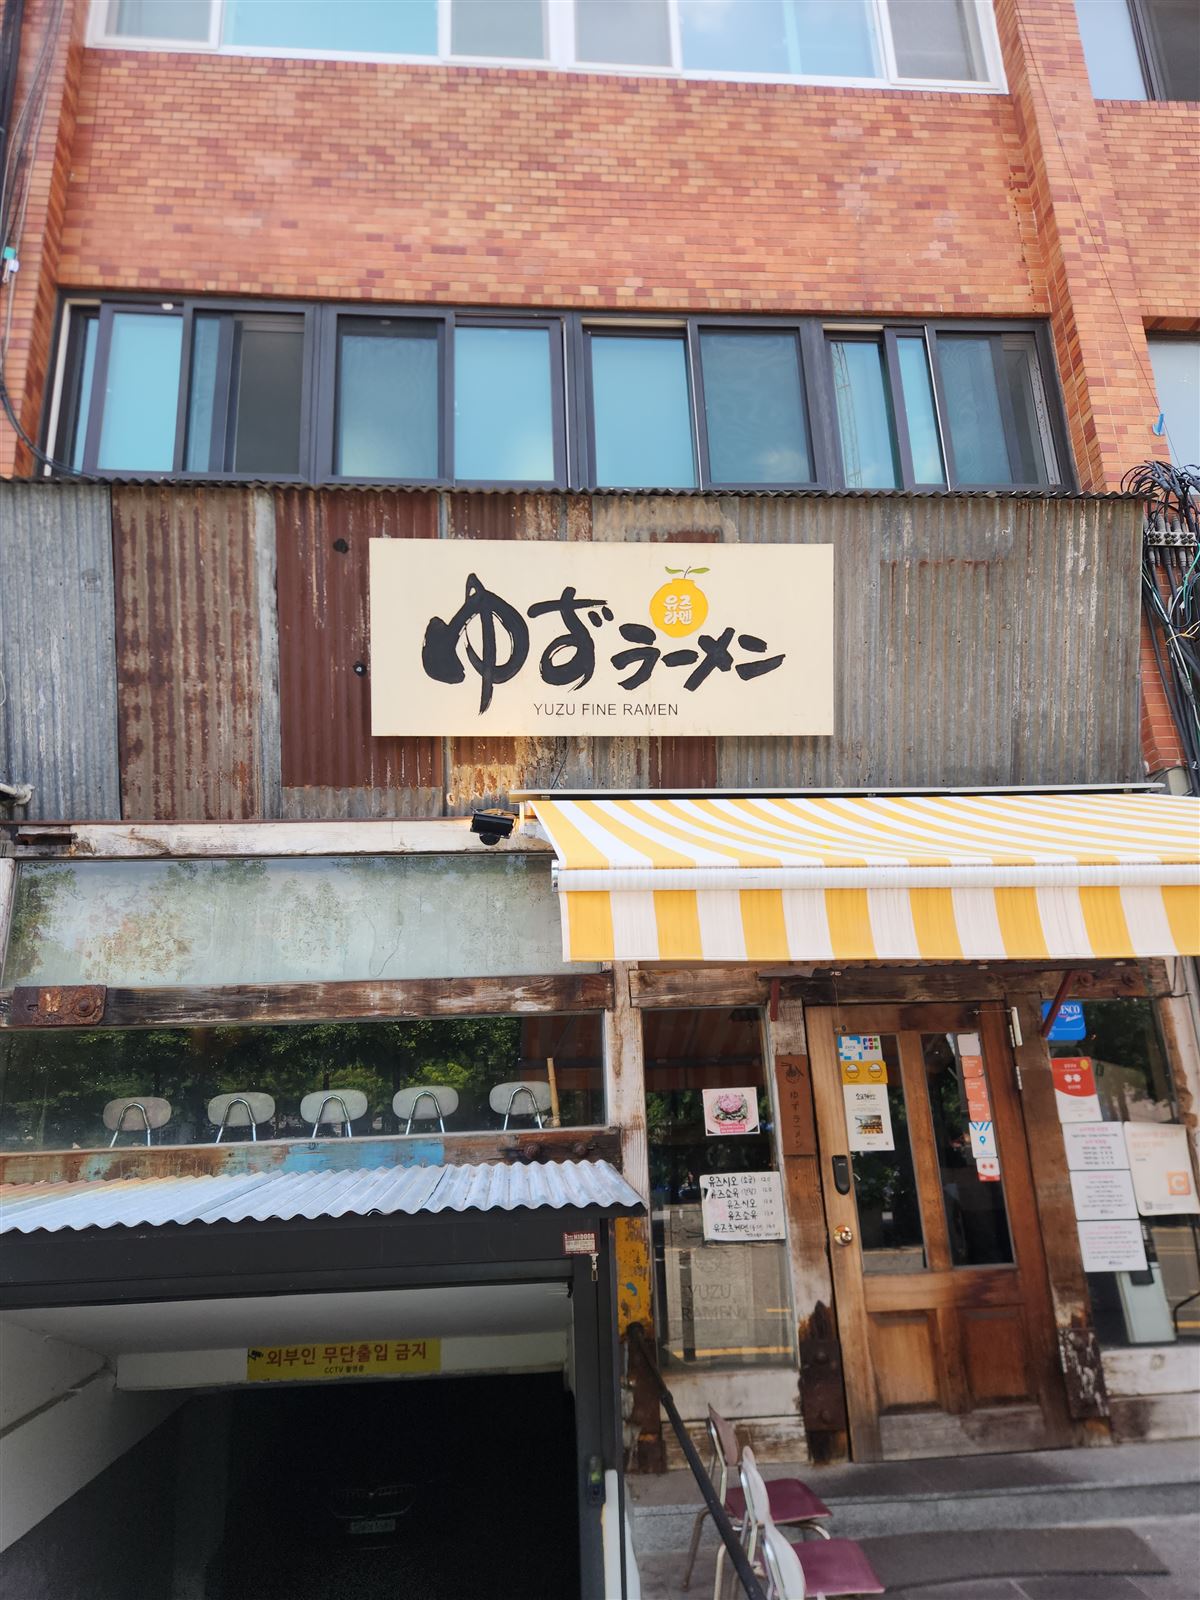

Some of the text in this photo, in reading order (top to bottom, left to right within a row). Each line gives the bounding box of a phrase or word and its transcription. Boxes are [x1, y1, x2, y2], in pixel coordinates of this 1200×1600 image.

[664, 594, 692, 611] 유즈
[664, 610, 692, 625] 라멘
[421, 572, 786, 716] ゆずラーメン
[533, 703, 679, 716] YUZU FINE RAMEN
[708, 1176, 739, 1187] 유즈시오
[266, 1342, 427, 1366] 외부인 무단출입 금지
[324, 1366, 344, 1374] CCTV
